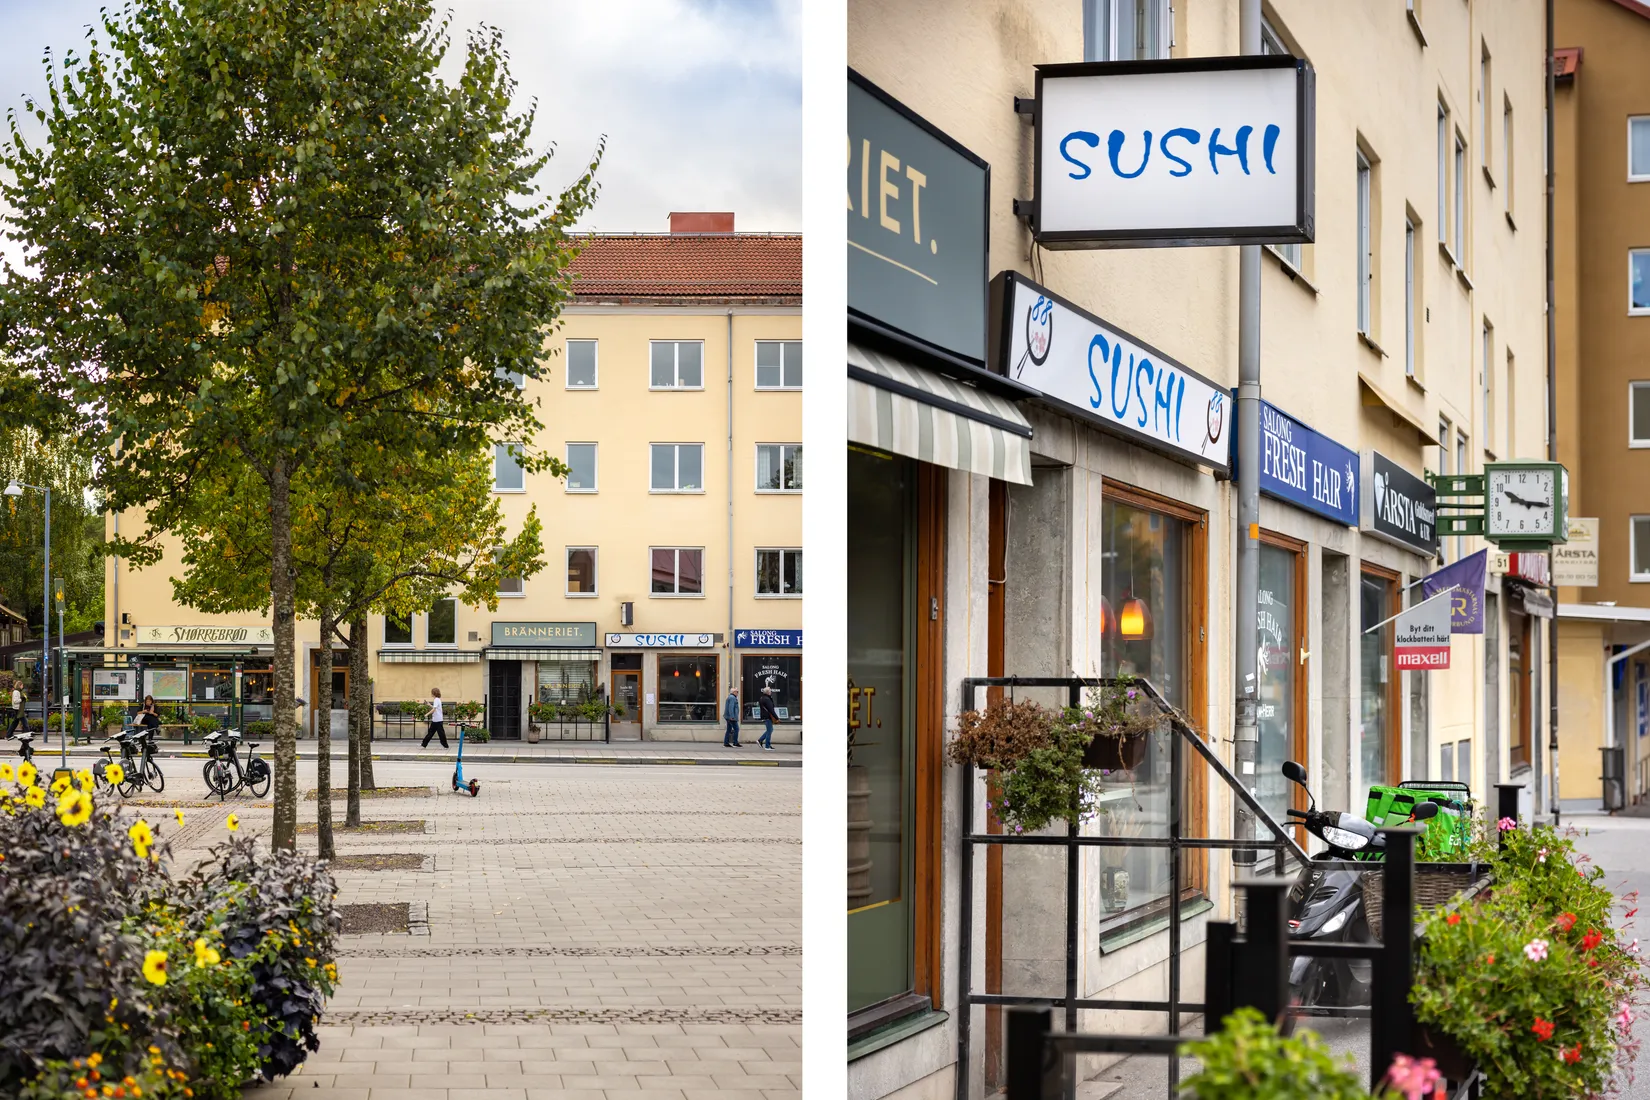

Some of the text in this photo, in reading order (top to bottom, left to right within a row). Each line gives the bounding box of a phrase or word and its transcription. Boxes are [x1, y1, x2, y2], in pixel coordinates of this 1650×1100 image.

[1059, 124, 1281, 180] SUSHI
[1032, 295, 1053, 326] 88
[1088, 334, 1185, 442] SUSHI
[1210, 390, 1223, 413] 88
[1263, 405, 1292, 443] SALONG
[1263, 429, 1342, 510] FRESH HAIR
[1504, 474, 1510, 484] 11
[1518, 473, 1526, 483] 12
[1536, 474, 1539, 484] 1
[1496, 483, 1503, 493] 10
[1543, 482, 1548, 492] 2
[1383, 471, 1416, 535] ÅRSTA
[1494, 497, 1499, 507] 9
[1497, 511, 1502, 521] 8
[1543, 511, 1548, 520] 4
[1505, 519, 1510, 529] 7
[1519, 519, 1524, 530] 6
[1535, 518, 1540, 529] 5
[1555, 548, 1596, 558] ÅRSTA
[1497, 558, 1507, 567] 51
[504, 626, 583, 637] BRÄNNERIET.
[1410, 625, 1435, 634] Byt ditt
[168, 627, 248, 643] SMØRREBRØD
[635, 634, 685, 646] SUSHI
[750, 635, 790, 645] FRESH
[1396, 635, 1450, 643] klockbatteri här!
[1398, 652, 1448, 665] maxell
[754, 669, 788, 679] FRESH HAIR
